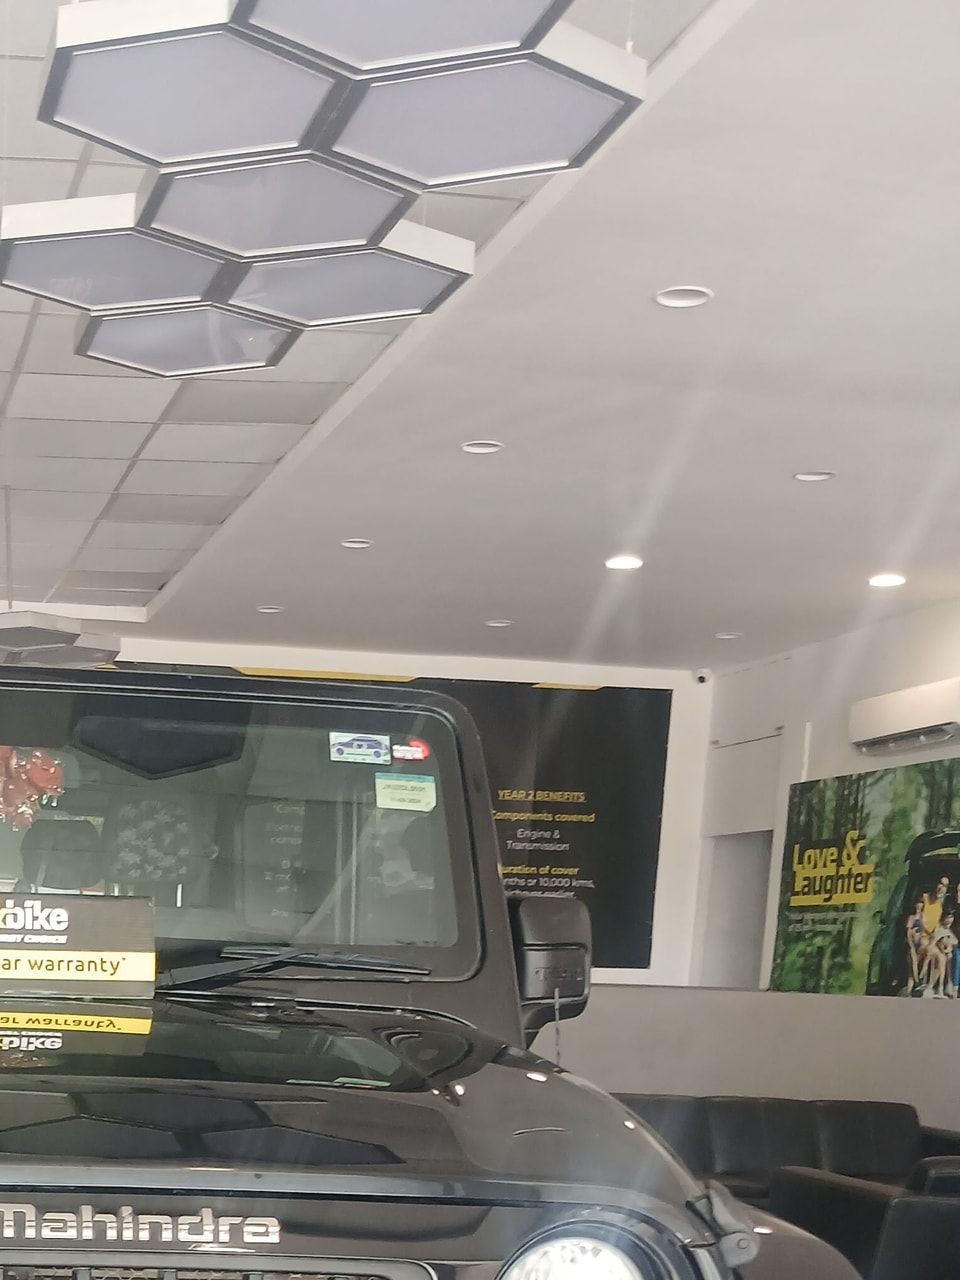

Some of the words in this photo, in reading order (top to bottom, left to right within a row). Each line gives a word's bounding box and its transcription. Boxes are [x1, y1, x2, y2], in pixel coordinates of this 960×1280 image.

[498, 790, 526, 800] YEAR
[527, 790, 535, 800] 2
[535, 791, 586, 802] BENEFITS
[516, 828, 552, 840] Engine
[506, 840, 570, 851] Transmission
[793, 843, 839, 870] Love
[841, 829, 867, 867] &
[790, 866, 874, 903] Laughter
